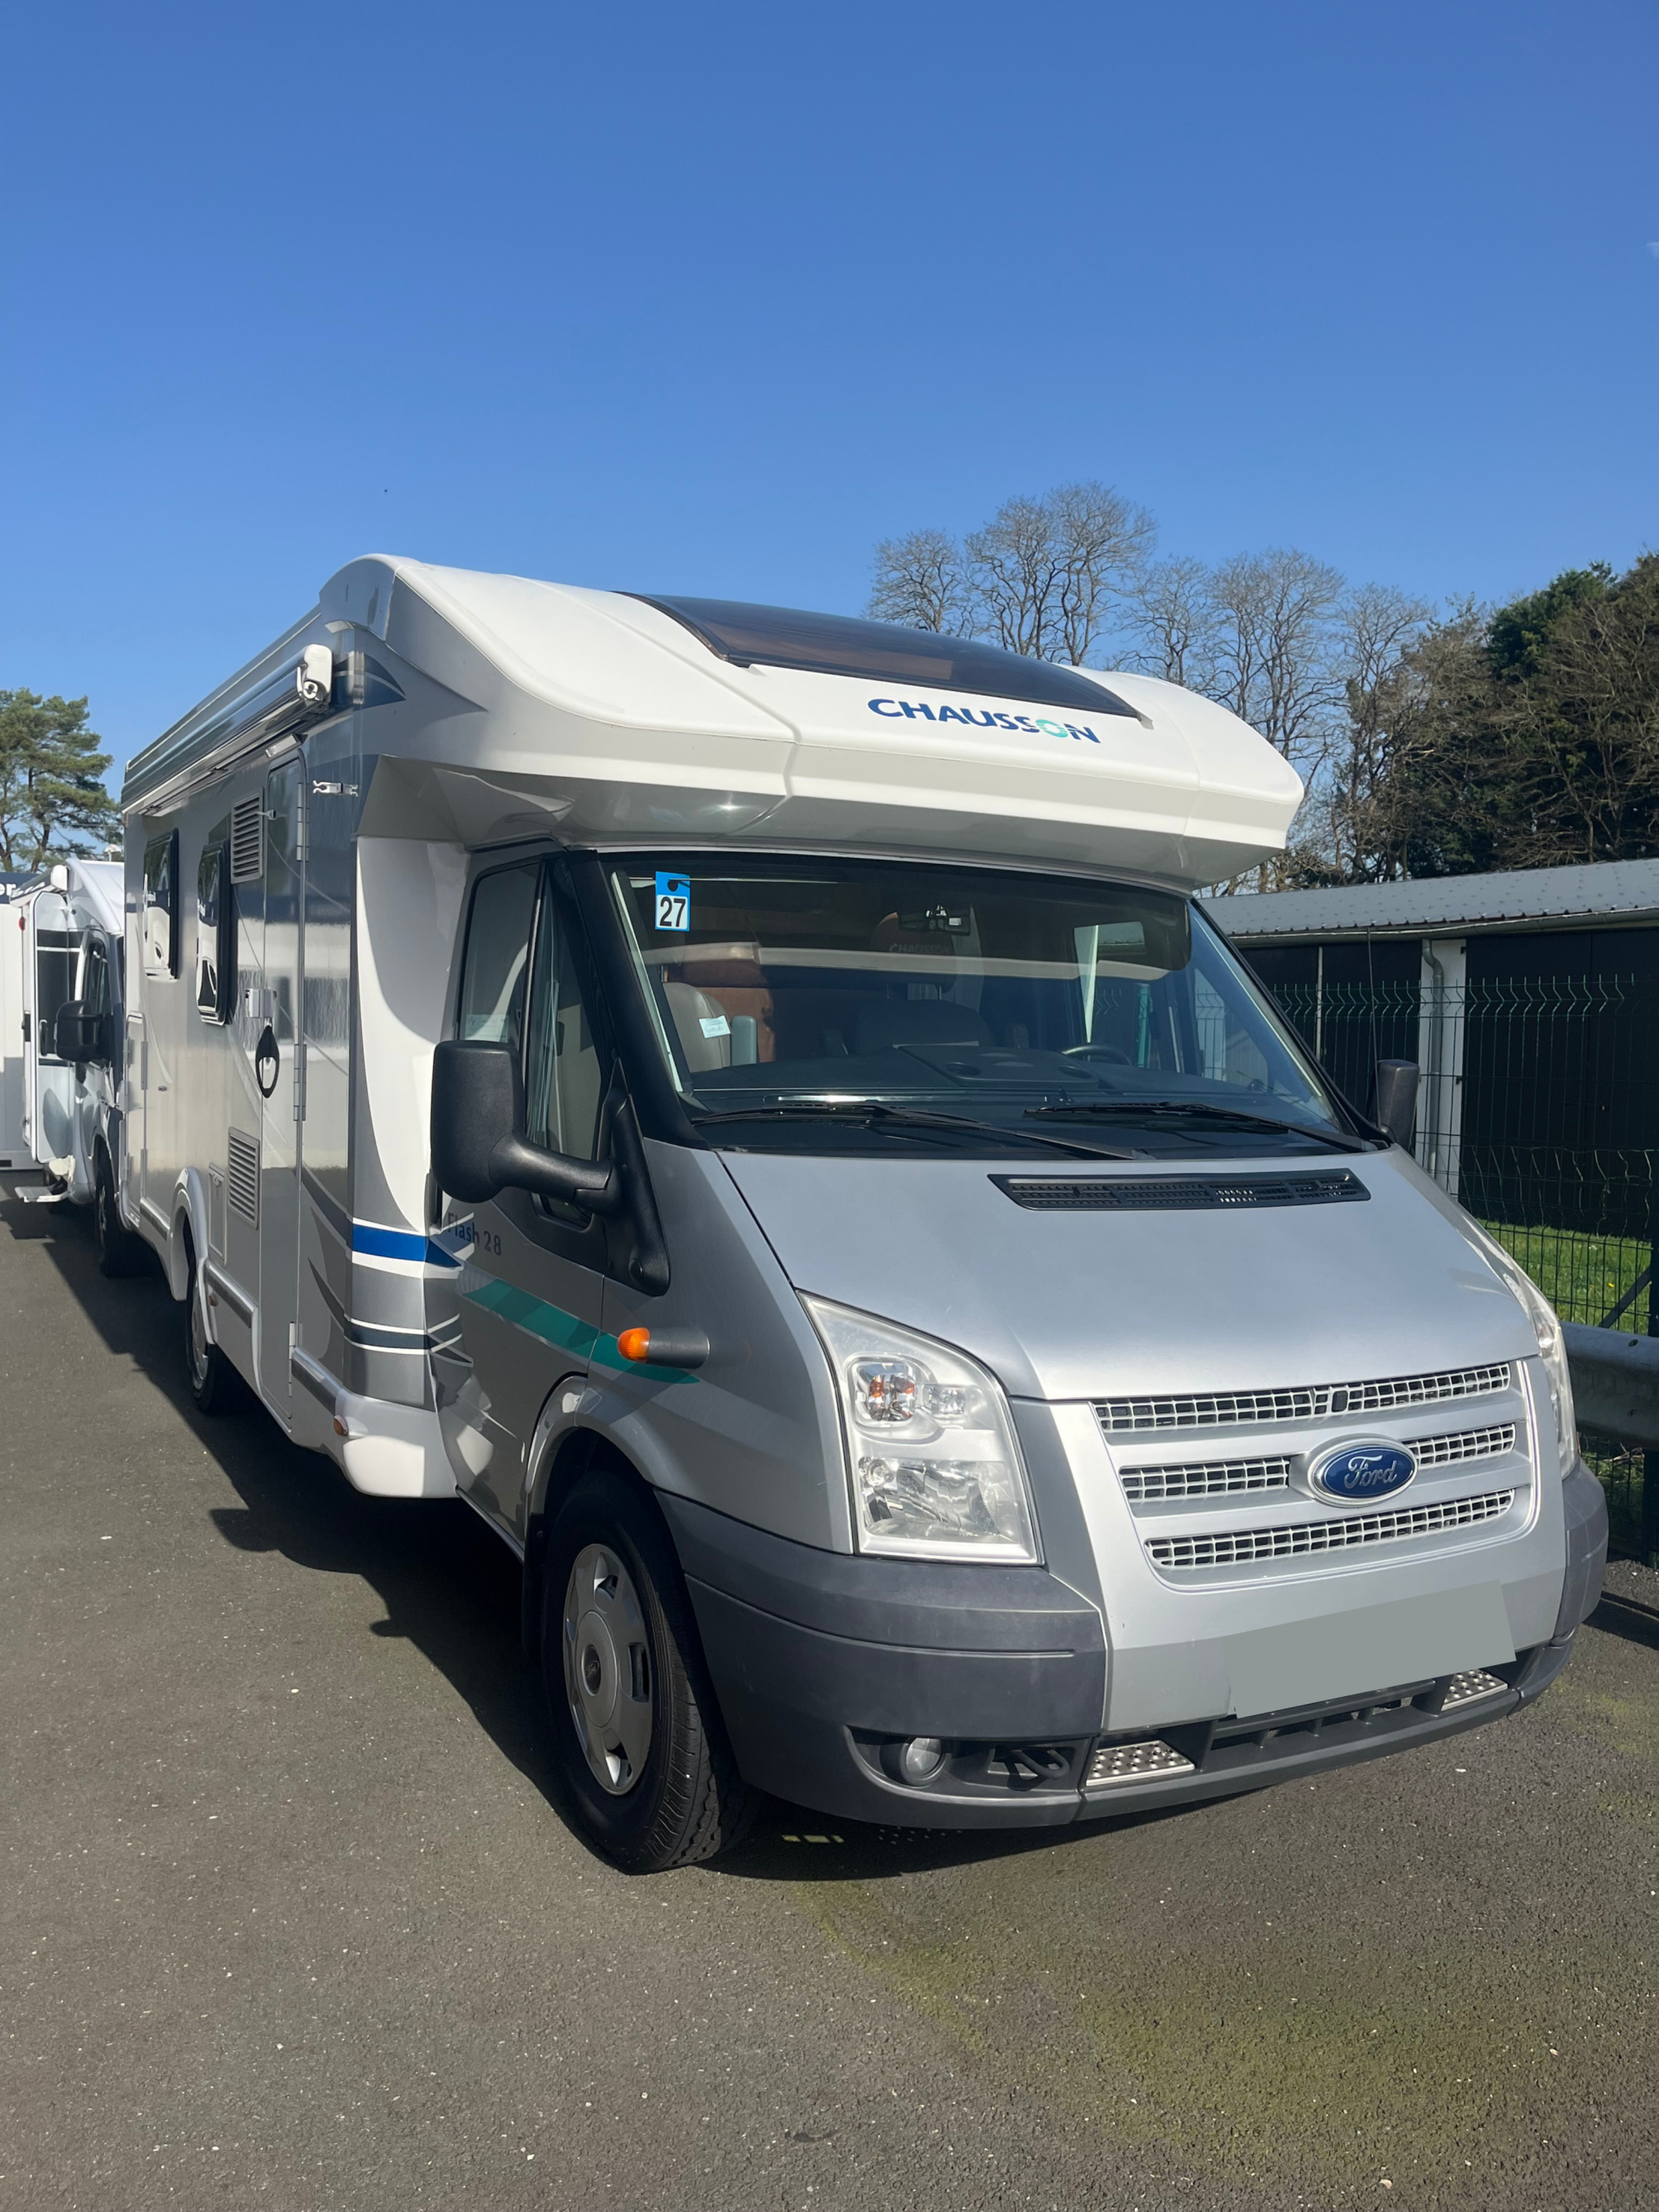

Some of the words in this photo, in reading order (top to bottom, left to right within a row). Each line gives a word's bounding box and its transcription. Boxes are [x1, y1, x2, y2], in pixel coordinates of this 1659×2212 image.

[868, 698, 1101, 743] CHAUSSON
[659, 896, 686, 927] 27
[448, 1212, 480, 1246] Flash
[484, 1230, 502, 1255] 28
[1344, 1454, 1397, 1490] Ford
